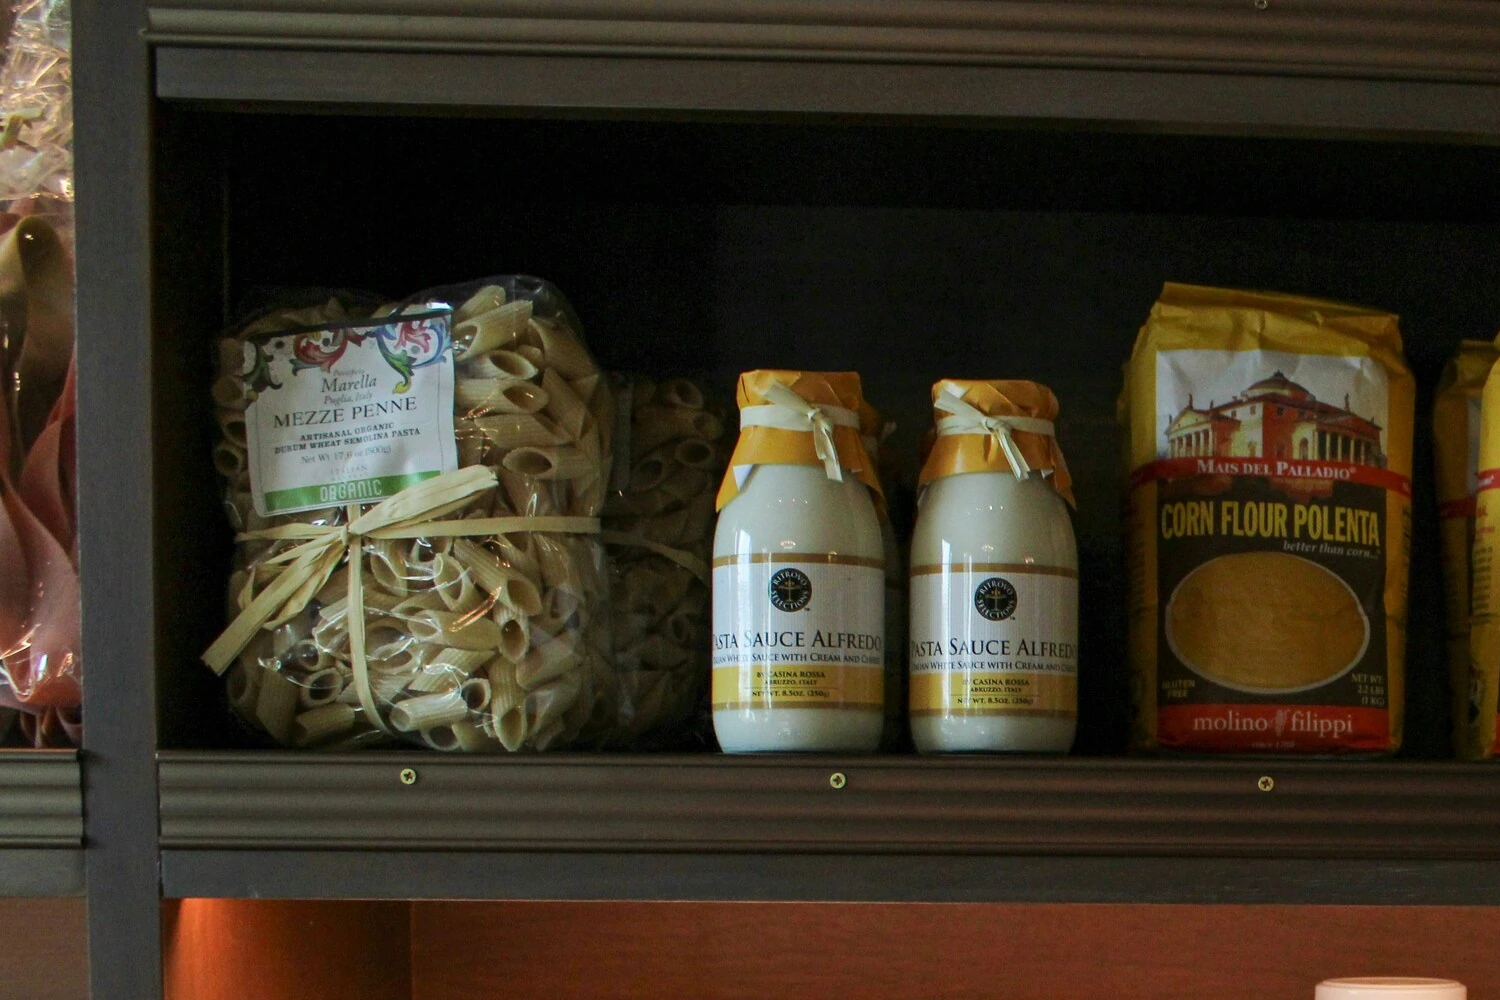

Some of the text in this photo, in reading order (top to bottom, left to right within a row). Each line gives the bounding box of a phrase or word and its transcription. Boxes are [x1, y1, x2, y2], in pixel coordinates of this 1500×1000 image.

[321, 375, 377, 392] Marella
[274, 397, 417, 428] MEZZE PENNE
[275, 429, 420, 454] DURUM WHEAT SEMOLINA PASTA
[300, 423, 393, 441] ARTISANAL ORGANIC
[1197, 459, 1238, 475] MAIS
[1243, 462, 1272, 476] DEL
[320, 480, 382, 501] ORGANIC
[1162, 500, 1380, 546] CORN FLOUR POLENTA
[1283, 540, 1344, 555] better than
[771, 571, 808, 610] RITROVO SELECTIONS
[977, 581, 1014, 619] RITROVO SELECTIONS
[745, 630, 882, 650] SAUCE ALFREDO
[950, 638, 1010, 656] SAUCE
[782, 653, 807, 661] WITH
[810, 654, 841, 662] CREAM
[1015, 661, 1043, 670] CREAM
[1193, 709, 1352, 735] molino filippi
